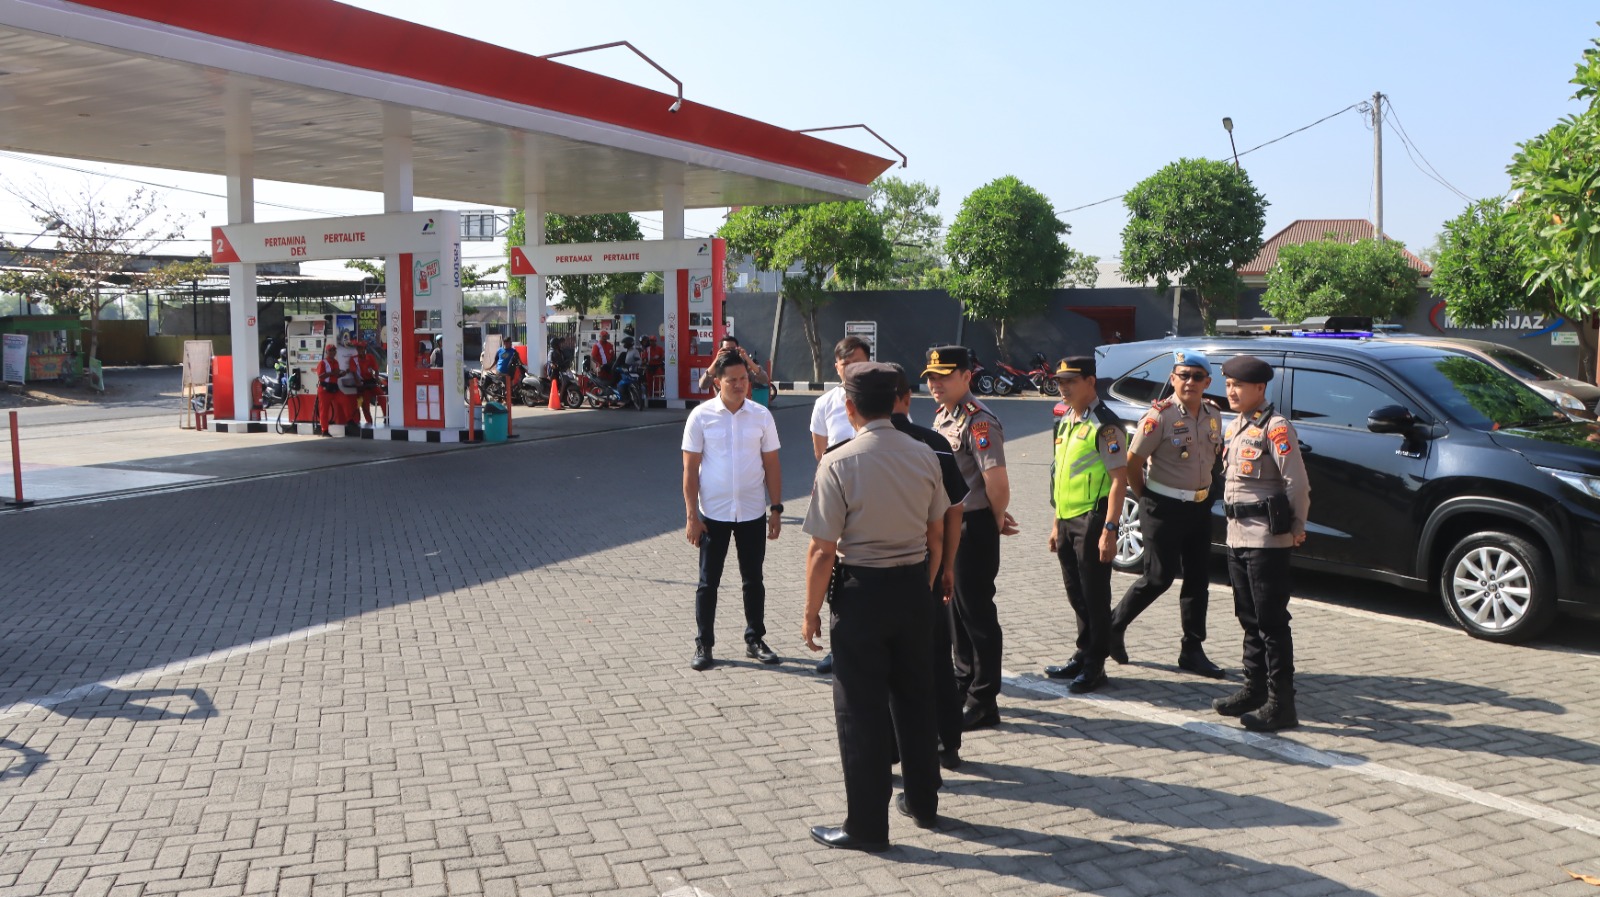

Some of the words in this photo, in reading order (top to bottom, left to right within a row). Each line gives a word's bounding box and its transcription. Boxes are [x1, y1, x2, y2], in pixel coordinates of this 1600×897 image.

[216, 238, 224, 253] 2
[264, 235, 306, 247] PERTAMINA
[323, 231, 366, 244] PERTALITE
[290, 246, 307, 256] DEX
[515, 255, 520, 268] 1
[555, 254, 593, 264] PERTAMAX
[603, 252, 640, 262] PERTALITE
